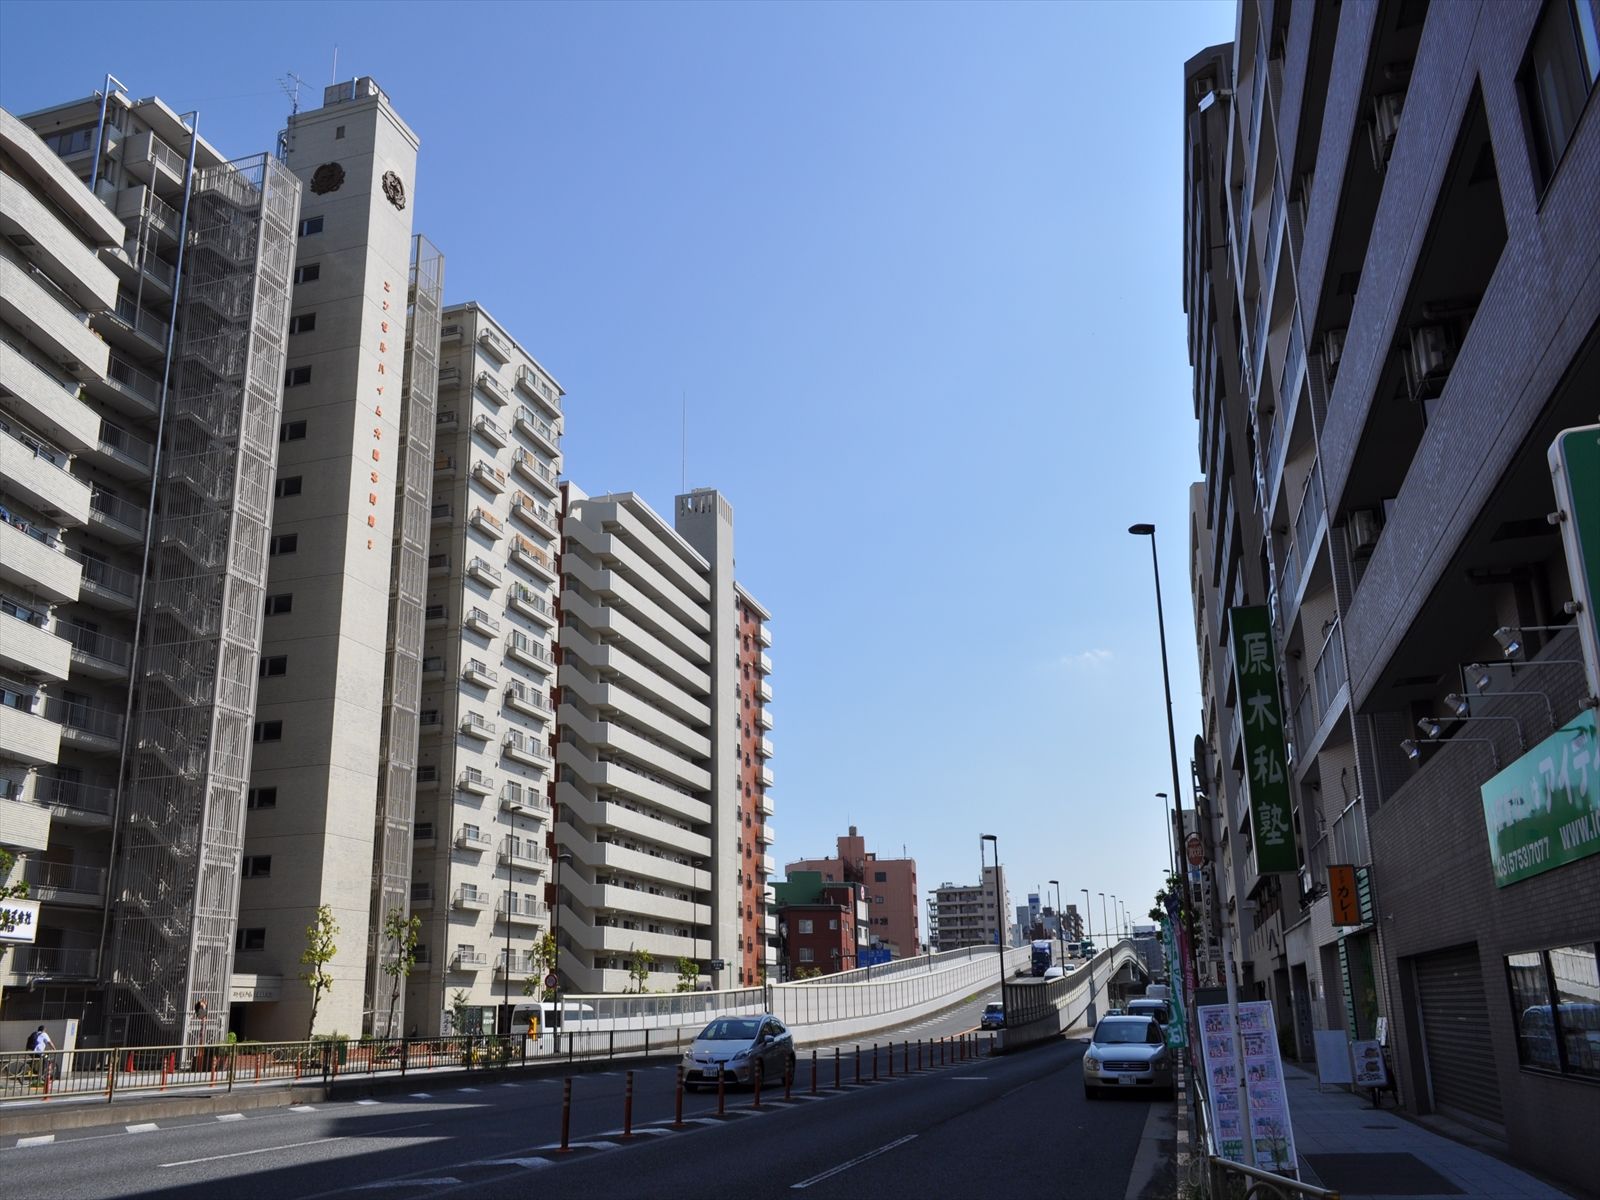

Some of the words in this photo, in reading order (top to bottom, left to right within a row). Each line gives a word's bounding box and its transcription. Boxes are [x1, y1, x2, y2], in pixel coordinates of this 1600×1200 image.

[1240, 631, 1289, 847] 原木私塾
[1497, 836, 1550, 876] 03(5753)7077
[1337, 885, 1351, 922] カレー
